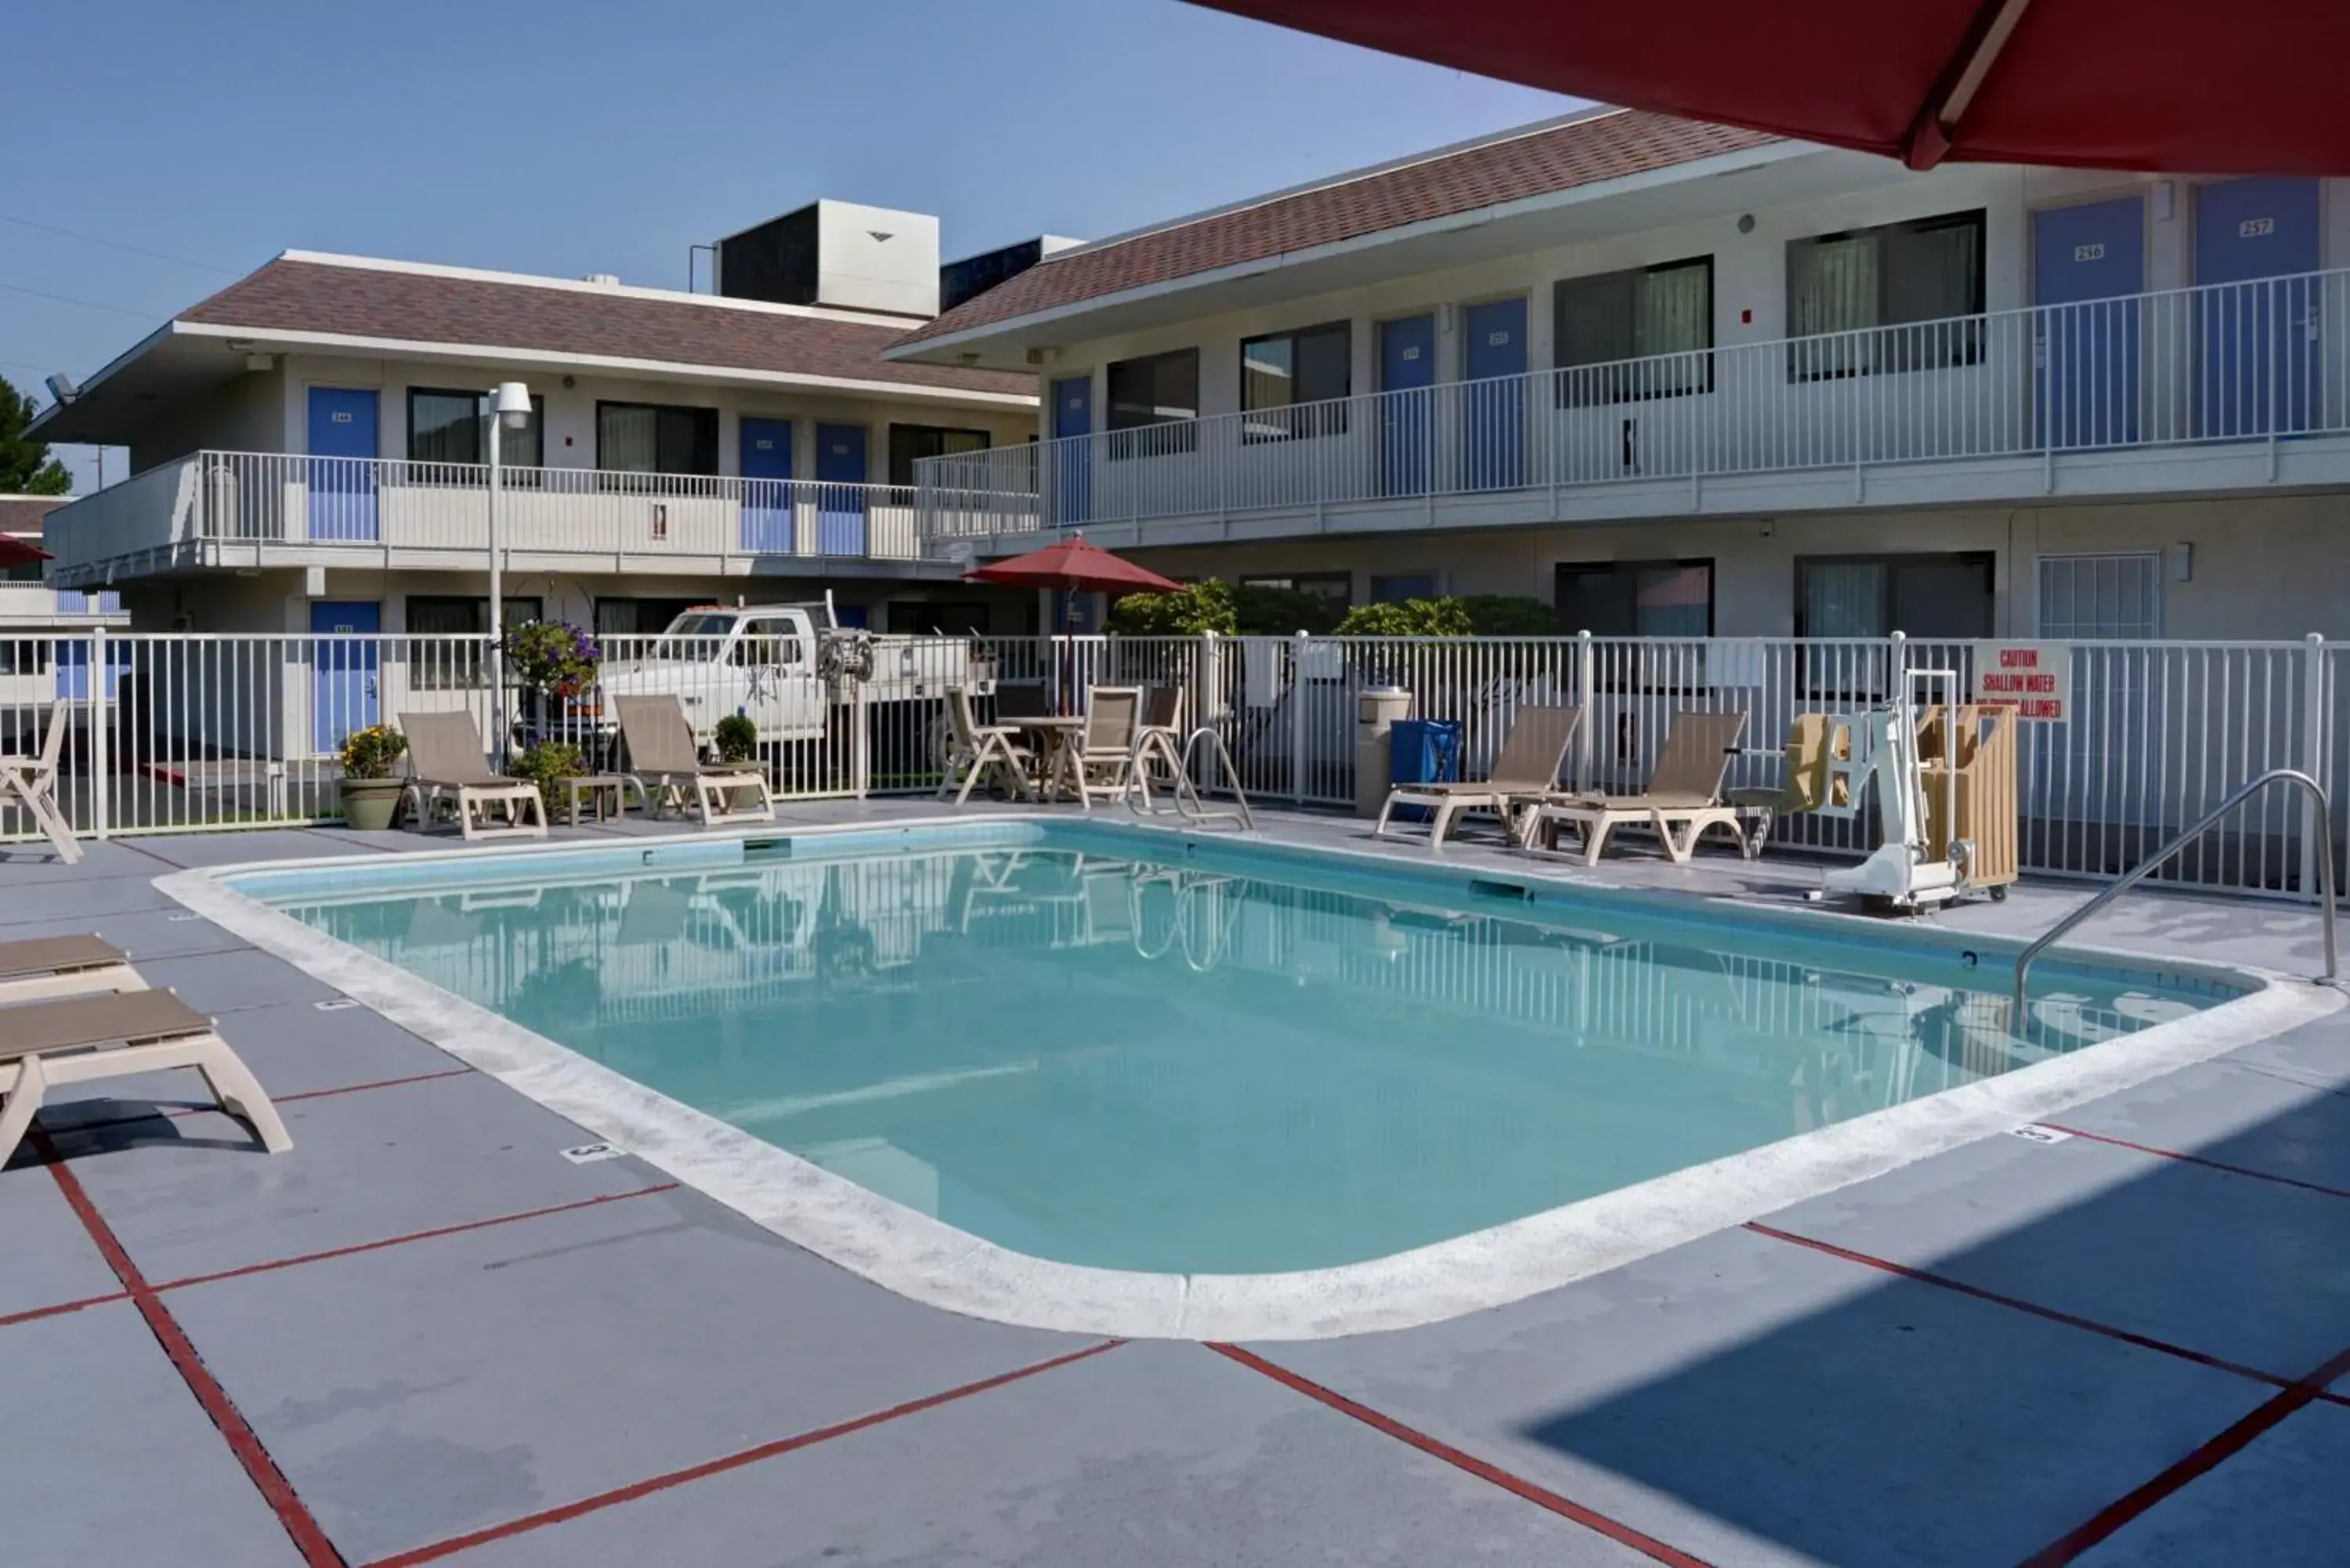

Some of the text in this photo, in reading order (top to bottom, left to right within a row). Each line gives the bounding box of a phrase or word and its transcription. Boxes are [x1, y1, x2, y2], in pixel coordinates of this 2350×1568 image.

[2000, 649, 2037, 667] CAUTION
[1983, 674, 2055, 692] SHALLOW WATER
[2020, 699, 2061, 718] ALLOWED
